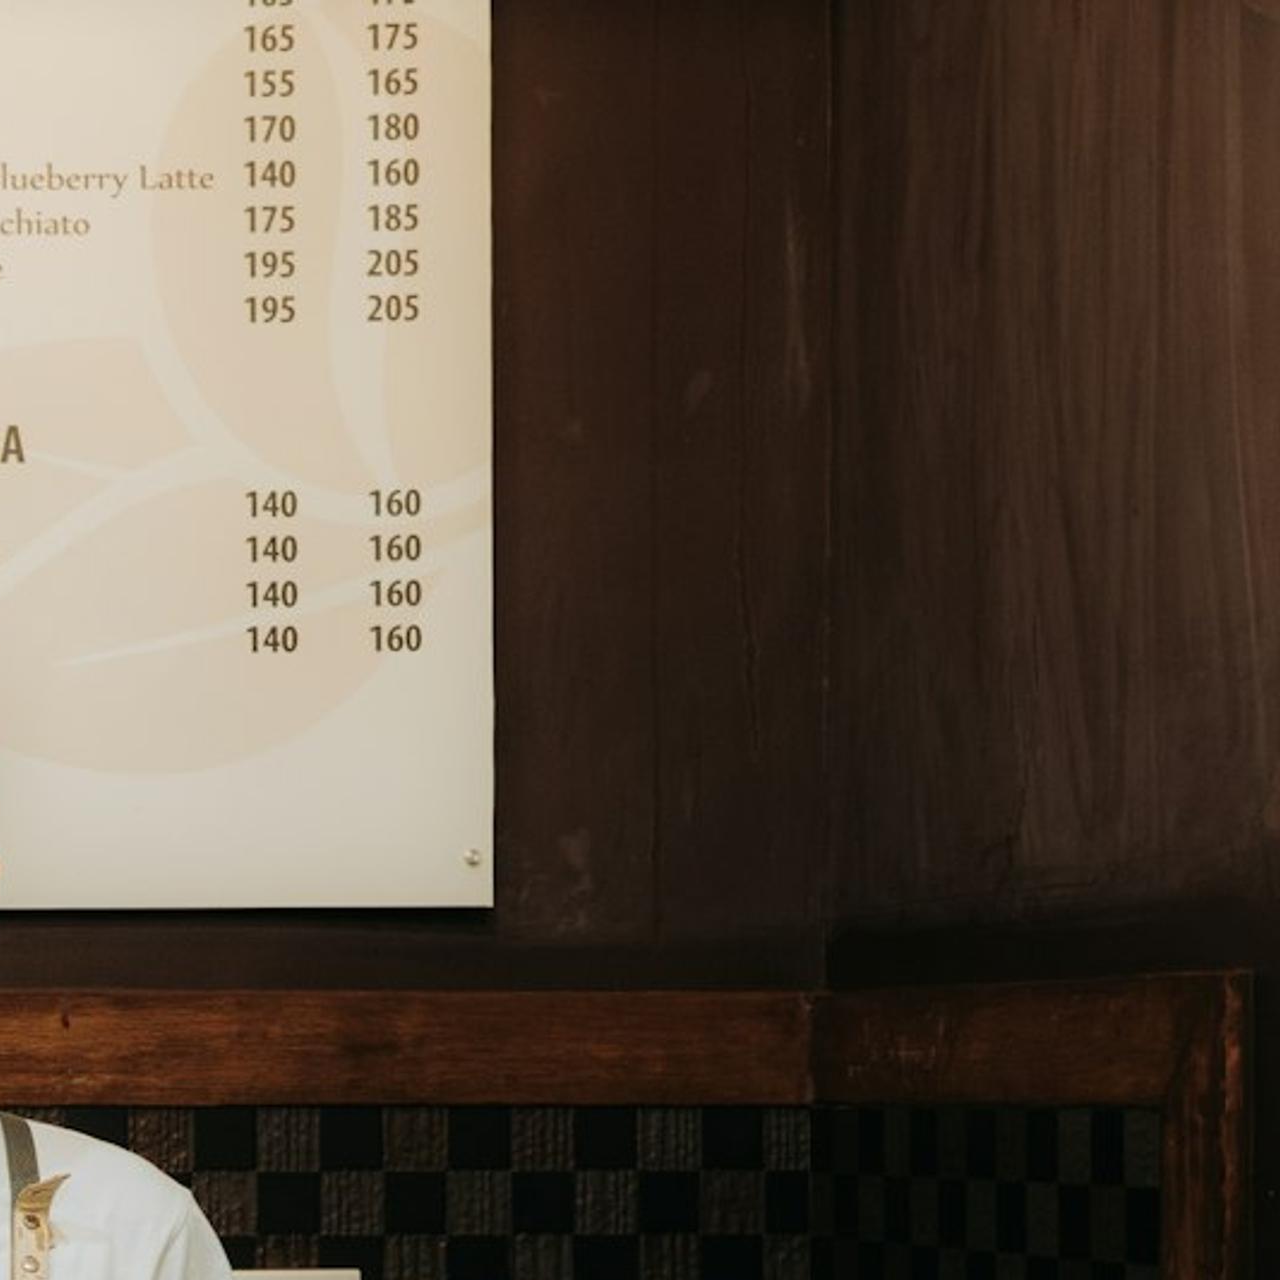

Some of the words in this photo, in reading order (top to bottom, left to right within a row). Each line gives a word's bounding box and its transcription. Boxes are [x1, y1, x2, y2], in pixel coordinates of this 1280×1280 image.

[245, 24, 294, 52] 165
[368, 22, 418, 50] 175
[244, 70, 295, 97] 155
[368, 68, 418, 96] 165
[244, 115, 295, 143] 170
[368, 113, 419, 140] 180
[140, 165, 214, 190] Latte
[245, 160, 296, 188] 140
[368, 158, 420, 186] 160
[245, 206, 295, 233] 175
[368, 204, 418, 231] 185
[245, 251, 295, 278] 195
[368, 249, 419, 276] 205
[245, 296, 295, 323] 195
[368, 294, 419, 322] 205
[246, 490, 297, 518] 140
[369, 489, 421, 517] 160
[247, 536, 297, 563] 140
[370, 534, 421, 561] 160
[247, 581, 298, 608] 140
[370, 580, 422, 606] 160
[247, 626, 298, 653] 140
[370, 625, 422, 652] 160
